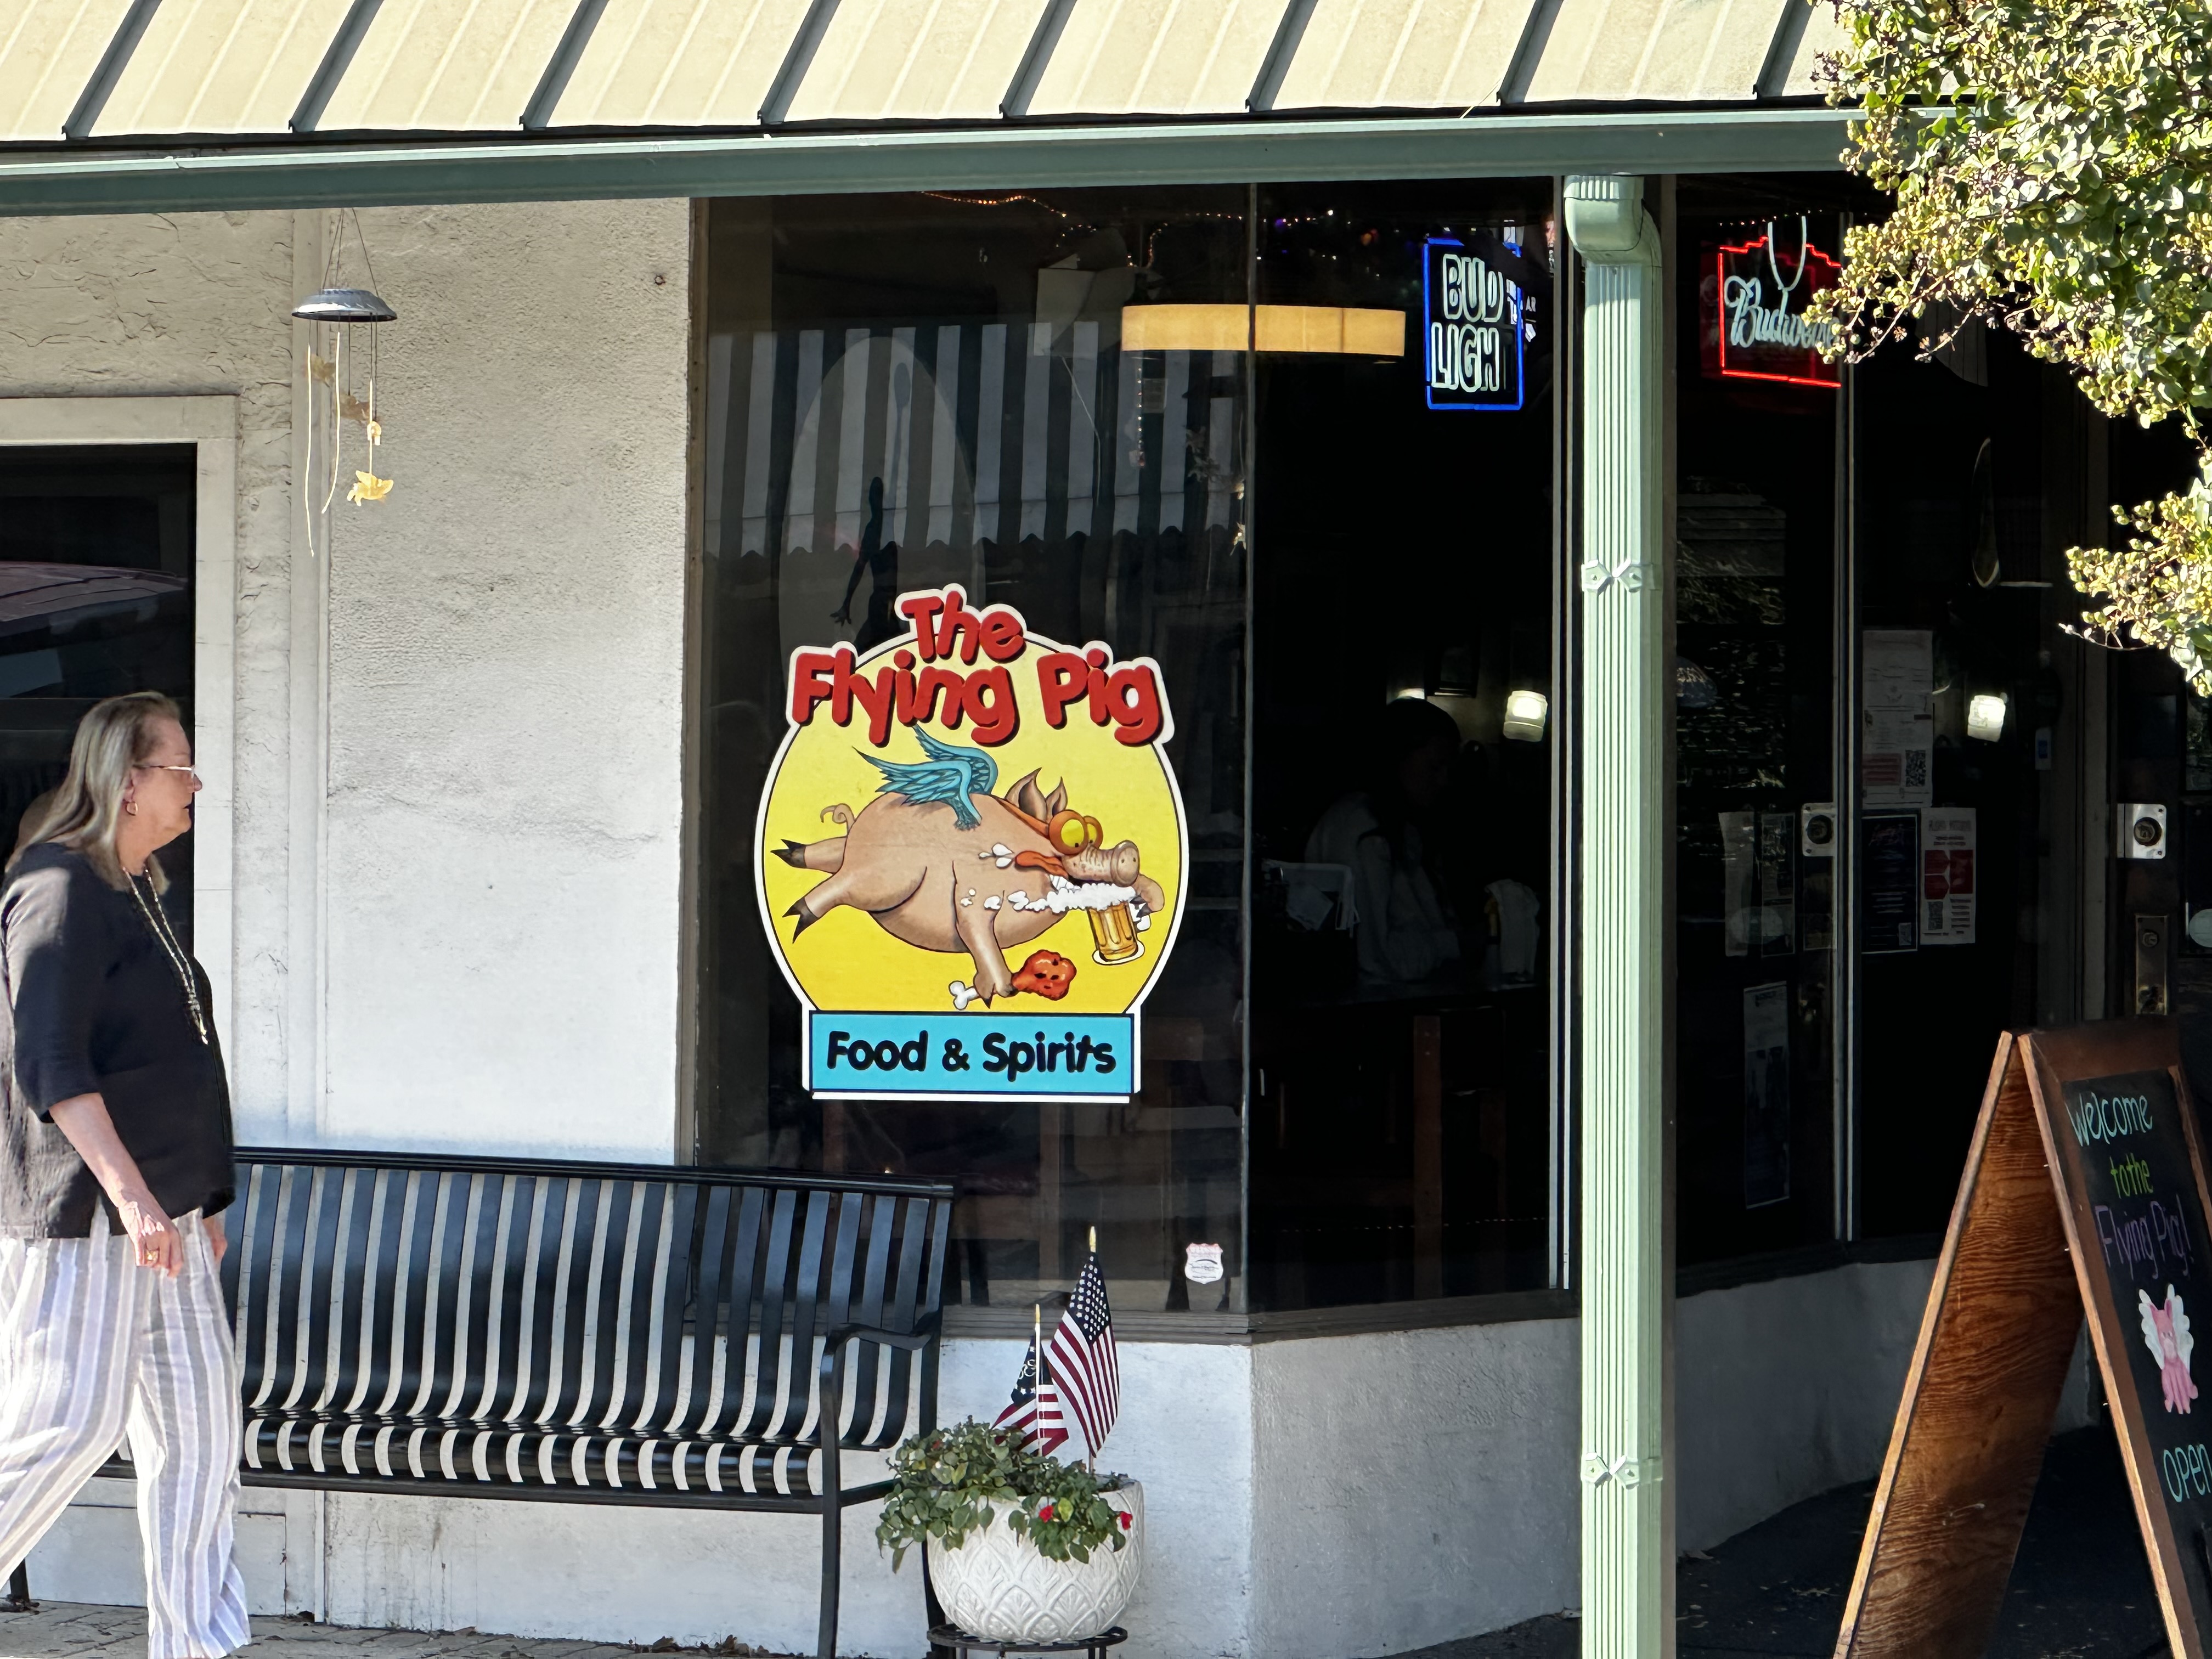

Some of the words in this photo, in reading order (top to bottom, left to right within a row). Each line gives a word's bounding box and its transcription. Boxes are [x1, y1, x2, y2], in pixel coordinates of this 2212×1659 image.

[1442, 253, 1504, 323] BUD
[1724, 275, 1840, 348] Budwei
[1431, 321, 1508, 393] LIGH
[901, 590, 1025, 665] The
[792, 648, 1020, 747] Flying
[1036, 648, 1163, 746] Pig
[827, 1030, 928, 1072] Food
[941, 1038, 970, 1072] &
[982, 1031, 1116, 1082] Spirits
[2095, 1205, 2159, 1281] Flying
[2149, 1193, 2194, 1277] Pig!
